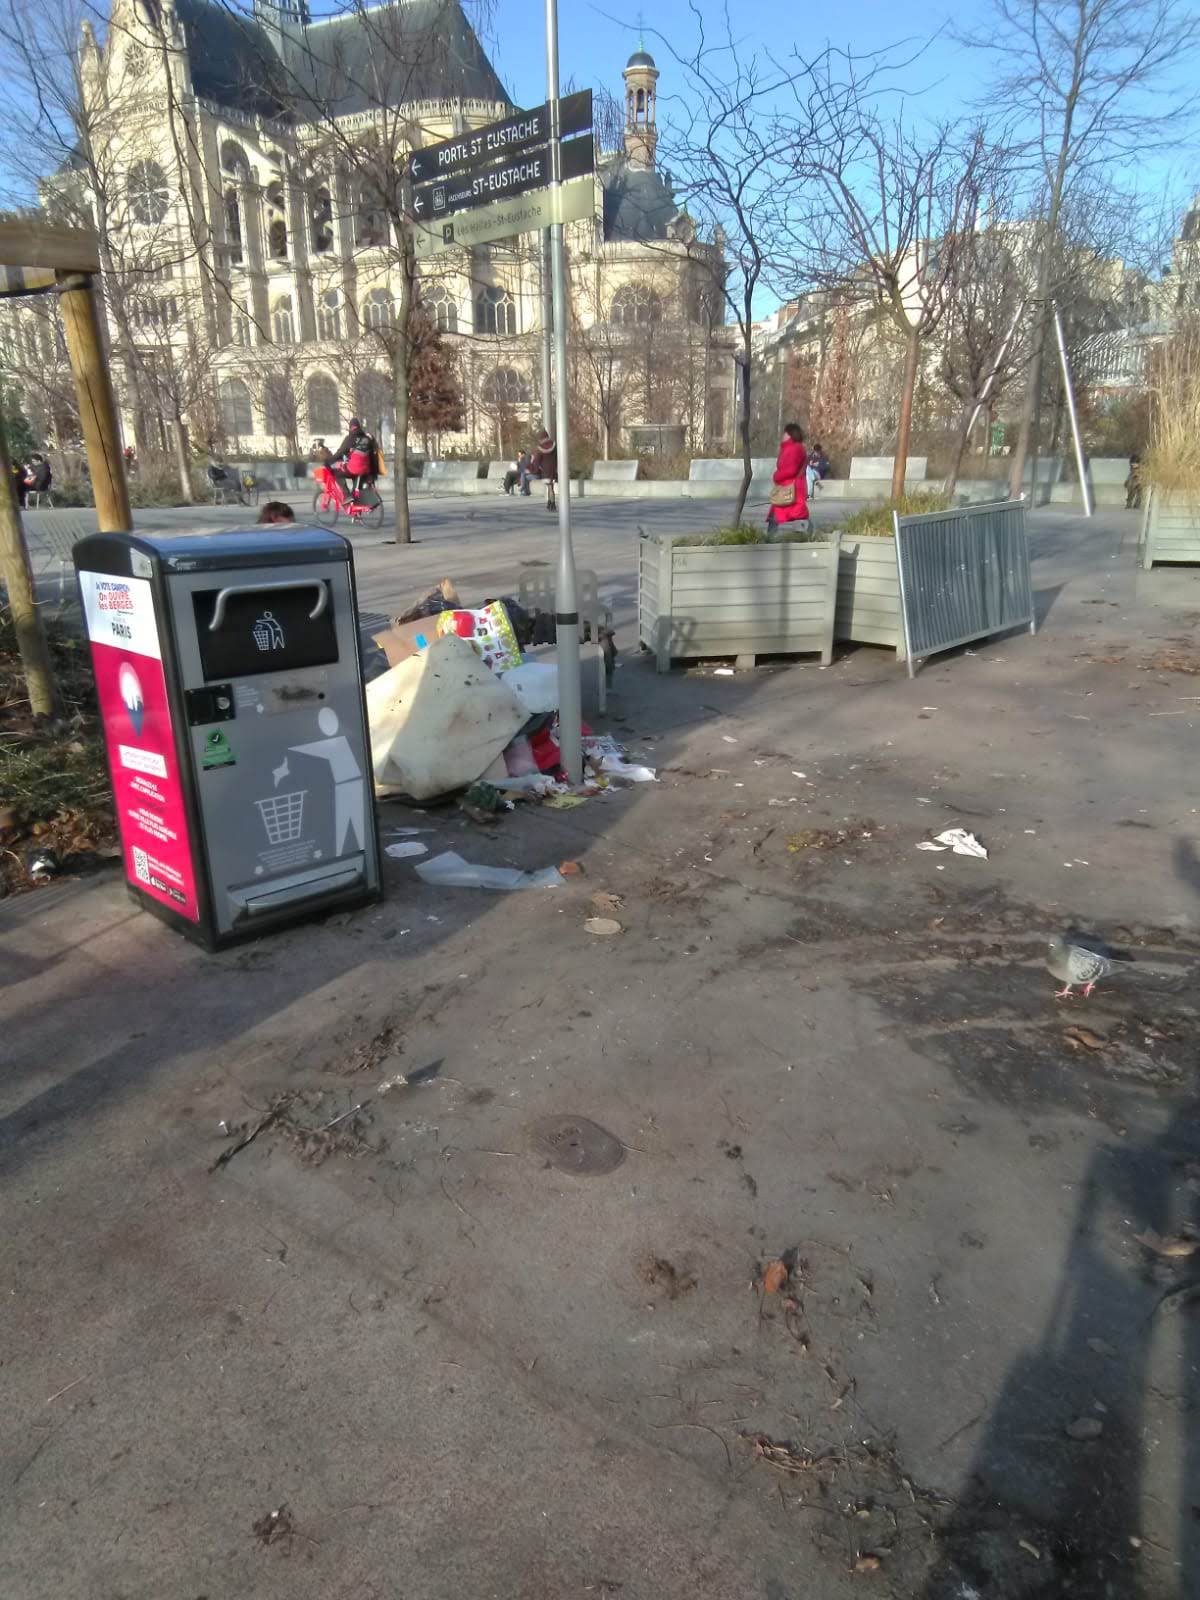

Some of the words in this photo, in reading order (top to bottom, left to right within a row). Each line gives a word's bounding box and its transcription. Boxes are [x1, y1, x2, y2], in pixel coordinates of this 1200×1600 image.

[438, 144, 468, 167] PORTE
[471, 138, 482, 155] ST
[487, 118, 539, 150] EUSTACHE
[472, 161, 541, 196] ST-EUSTACHE
[111, 621, 132, 639] PARIS
